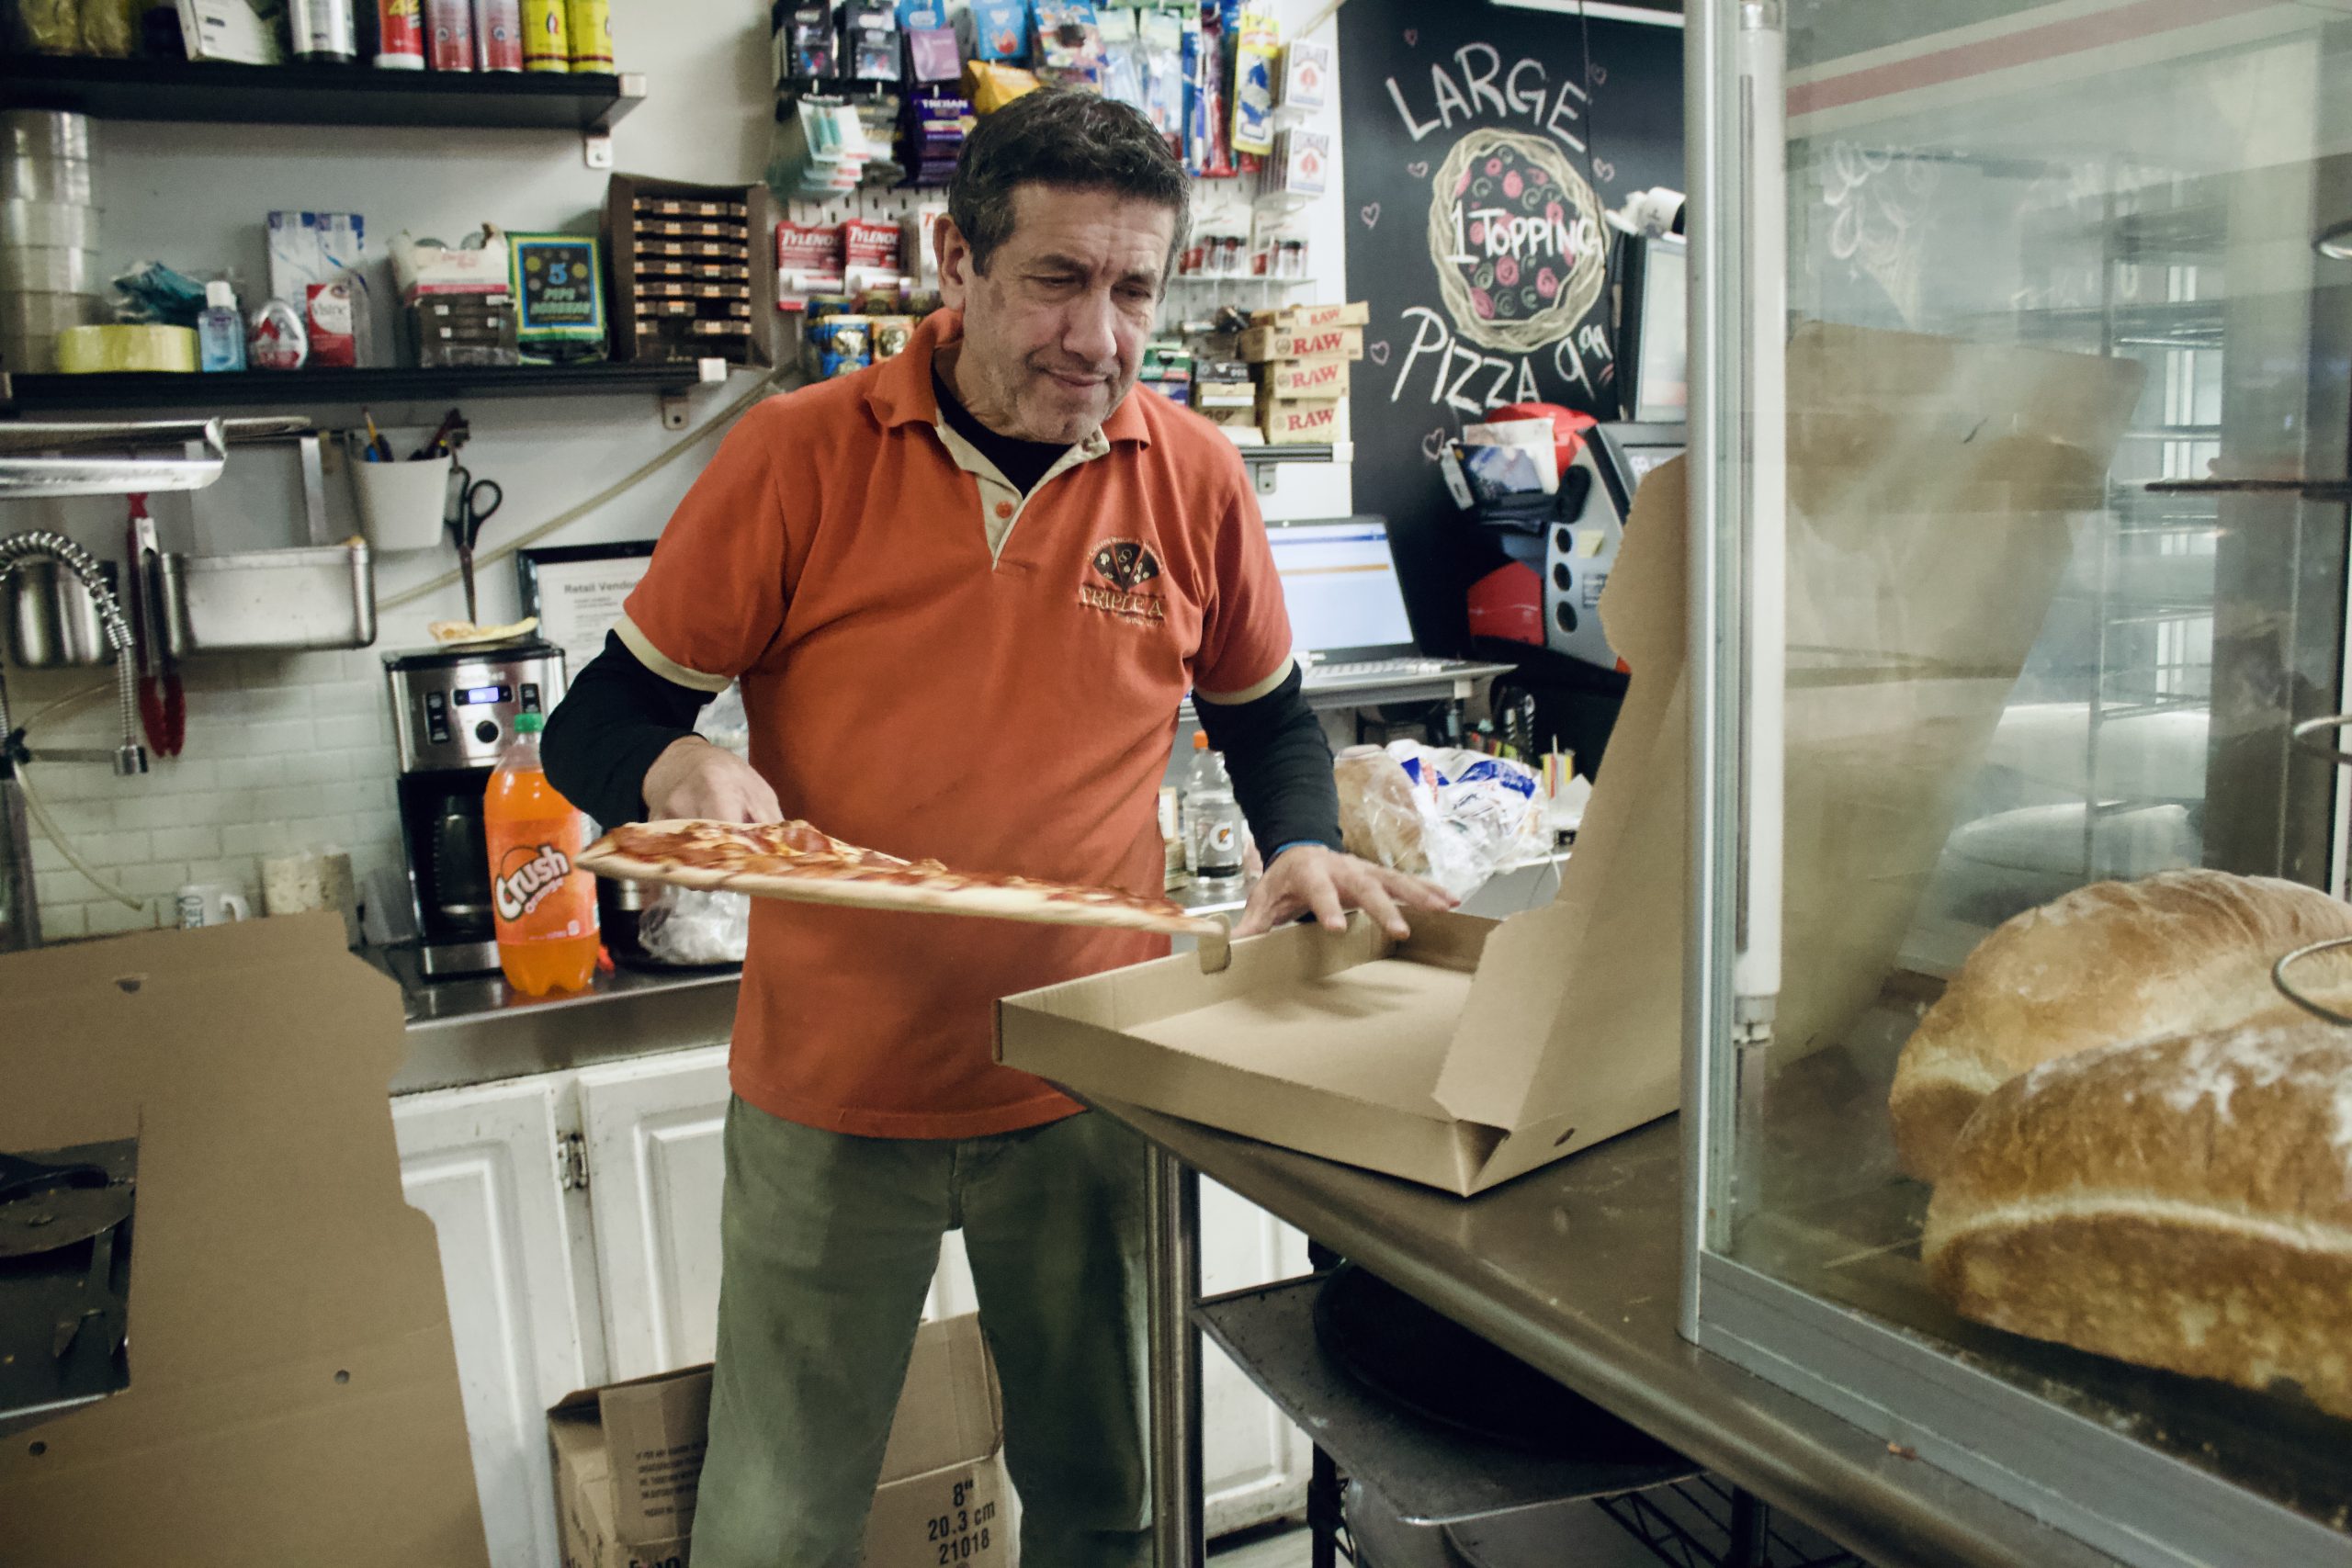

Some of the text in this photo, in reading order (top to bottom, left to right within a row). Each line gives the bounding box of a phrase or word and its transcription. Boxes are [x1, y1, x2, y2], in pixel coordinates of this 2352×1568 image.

[922, 99, 968, 108] TROJAN
[1385, 42, 1588, 153] LARGE
[1444, 199, 1606, 266] 1 TOPPING
[548, 263, 568, 285] 5
[1310, 308, 1340, 325] RAW
[1292, 333, 1344, 355] RAW
[1390, 306, 1543, 416] PIZZA
[1292, 365, 1339, 389] RAW
[1288, 409, 1335, 432] RAW
[1079, 587, 1164, 616] TRIPLE A
[1209, 820, 1235, 852] G
[496, 843, 570, 921] Crush
[953, 1479, 974, 1507] 8"
[928, 1501, 996, 1542] 20.3 cm
[938, 1528, 989, 1565] 21018
